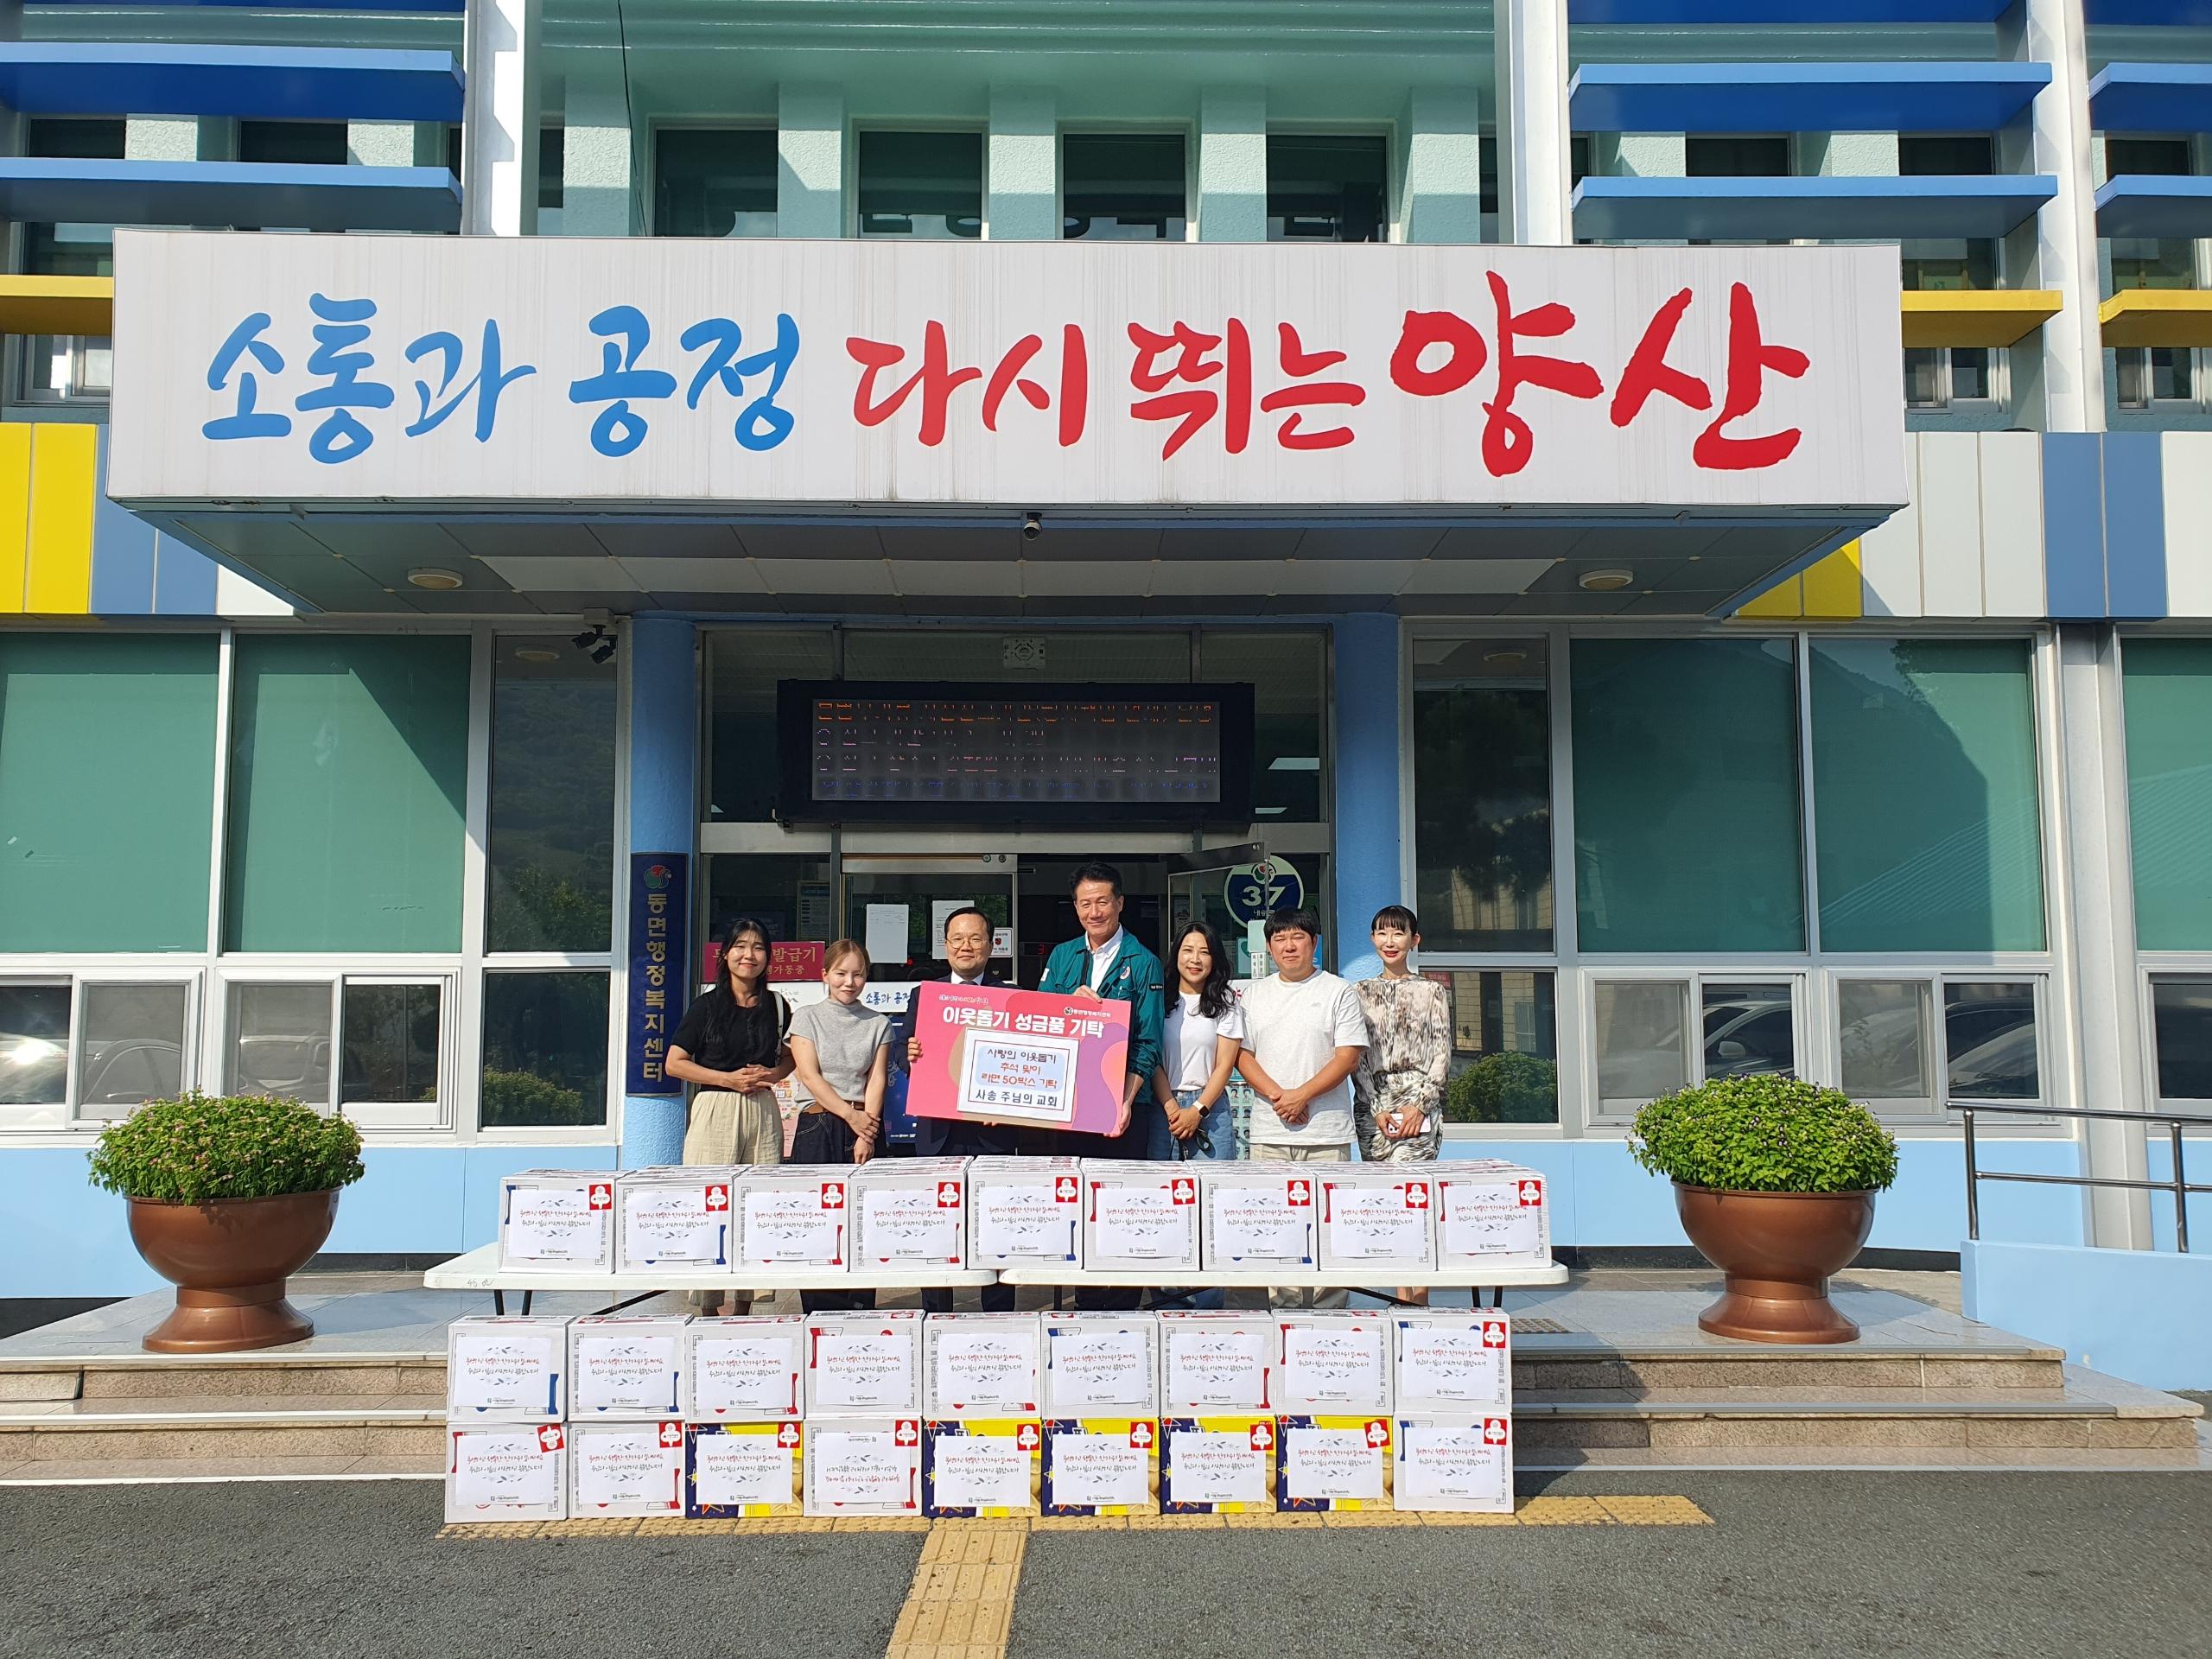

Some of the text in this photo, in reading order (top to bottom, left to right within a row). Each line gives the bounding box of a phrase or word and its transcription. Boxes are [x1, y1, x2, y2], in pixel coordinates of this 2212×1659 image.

[202, 270, 1810, 478] 소통과 공정 다시 뛰는 양산
[1242, 886, 1286, 906] 37
[643, 893, 668, 1082] 동면행정복지센터
[866, 991, 892, 1006] 소통과
[943, 1007, 1104, 1038] 이웃돕기 성금품 기탁
[988, 1049, 1057, 1064] 사랑의 이웃돕기
[1001, 1062, 1041, 1075] 추석 맞이
[982, 1073, 1058, 1089] 라면 50박스 기탁
[976, 1090, 1057, 1107] 사송 주님의 교회
